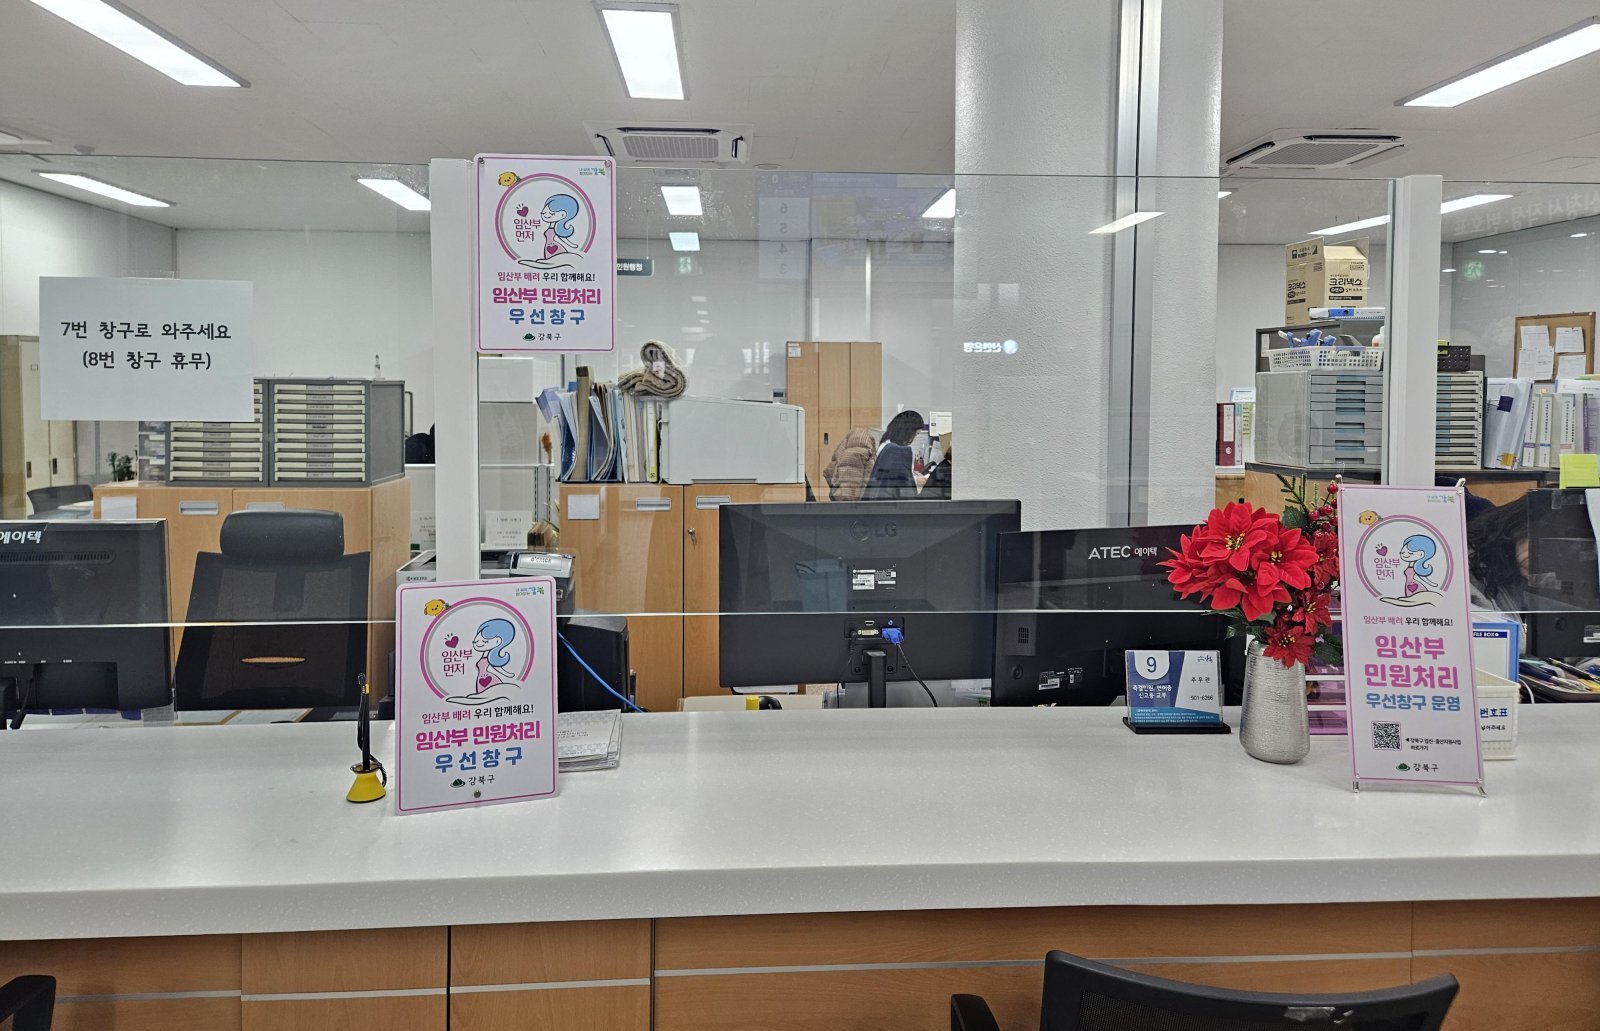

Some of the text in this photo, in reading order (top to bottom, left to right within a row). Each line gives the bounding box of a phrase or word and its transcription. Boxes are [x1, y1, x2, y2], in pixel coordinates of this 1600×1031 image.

[514, 219, 541, 230] 임산부
[515, 231, 534, 242] 먼저
[497, 272, 596, 282] 임산부 배려 우리 함께해요!
[1329, 278, 1363, 286] 크리넥스
[492, 288, 600, 304] 임산부 민원처리
[509, 308, 586, 325] 우선창구
[61, 321, 231, 340] 7번 창구로 와주세요
[538, 332, 562, 341] 강북구
[82, 351, 212, 370] (8번 창구 휴무)
[0, 530, 42, 544] 에이텍
[874, 523, 897, 537] LG
[1088, 546, 1157, 560] ATEC 에이텍
[1374, 558, 1400, 569] 임산부
[1376, 569, 1395, 580] 먼저
[1364, 616, 1453, 627] 임산부 배려 우리 함께해요!
[1375, 636, 1444, 660] 임산부
[442, 649, 473, 663] 임산부
[444, 662, 465, 676] 먼저
[1146, 656, 1157, 672] 9
[1364, 664, 1459, 689] 민원처리
[1366, 693, 1460, 712] 우선창구 운영
[422, 704, 534, 724] 임산부 배려 우리 함께해요!
[1480, 708, 1508, 718] 번호표
[416, 721, 540, 750] 임산부 민원처리
[435, 746, 522, 773] 우선창구
[1413, 762, 1439, 772] 강북구
[468, 774, 496, 785] 강북구
